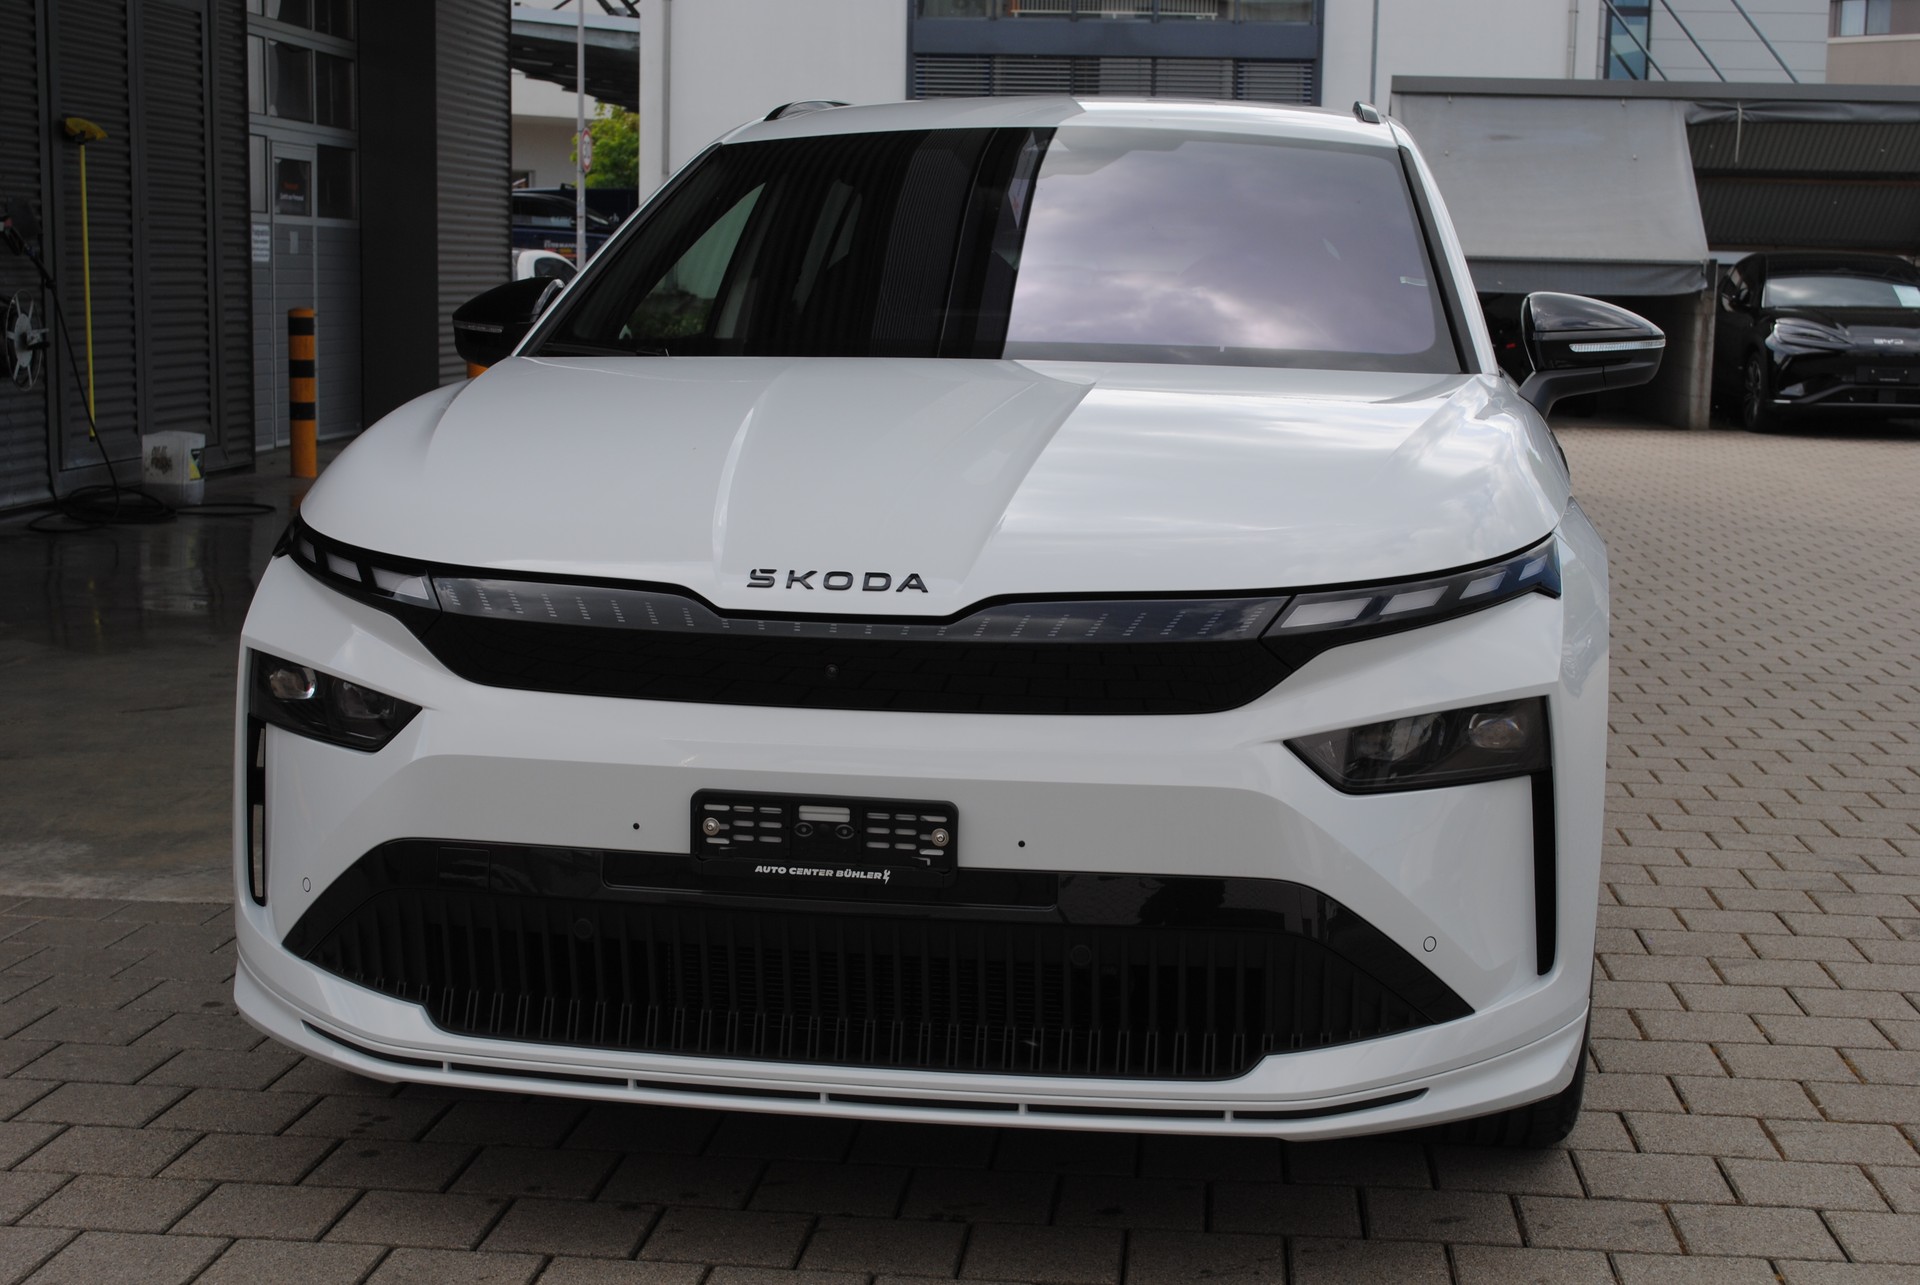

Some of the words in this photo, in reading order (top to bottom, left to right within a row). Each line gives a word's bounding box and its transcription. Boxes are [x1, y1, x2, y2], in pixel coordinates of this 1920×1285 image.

[746, 568, 929, 593] SKODA
[755, 865, 787, 874] AUTO
[788, 867, 834, 877] CENTER
[835, 869, 883, 880] BÜHLER
